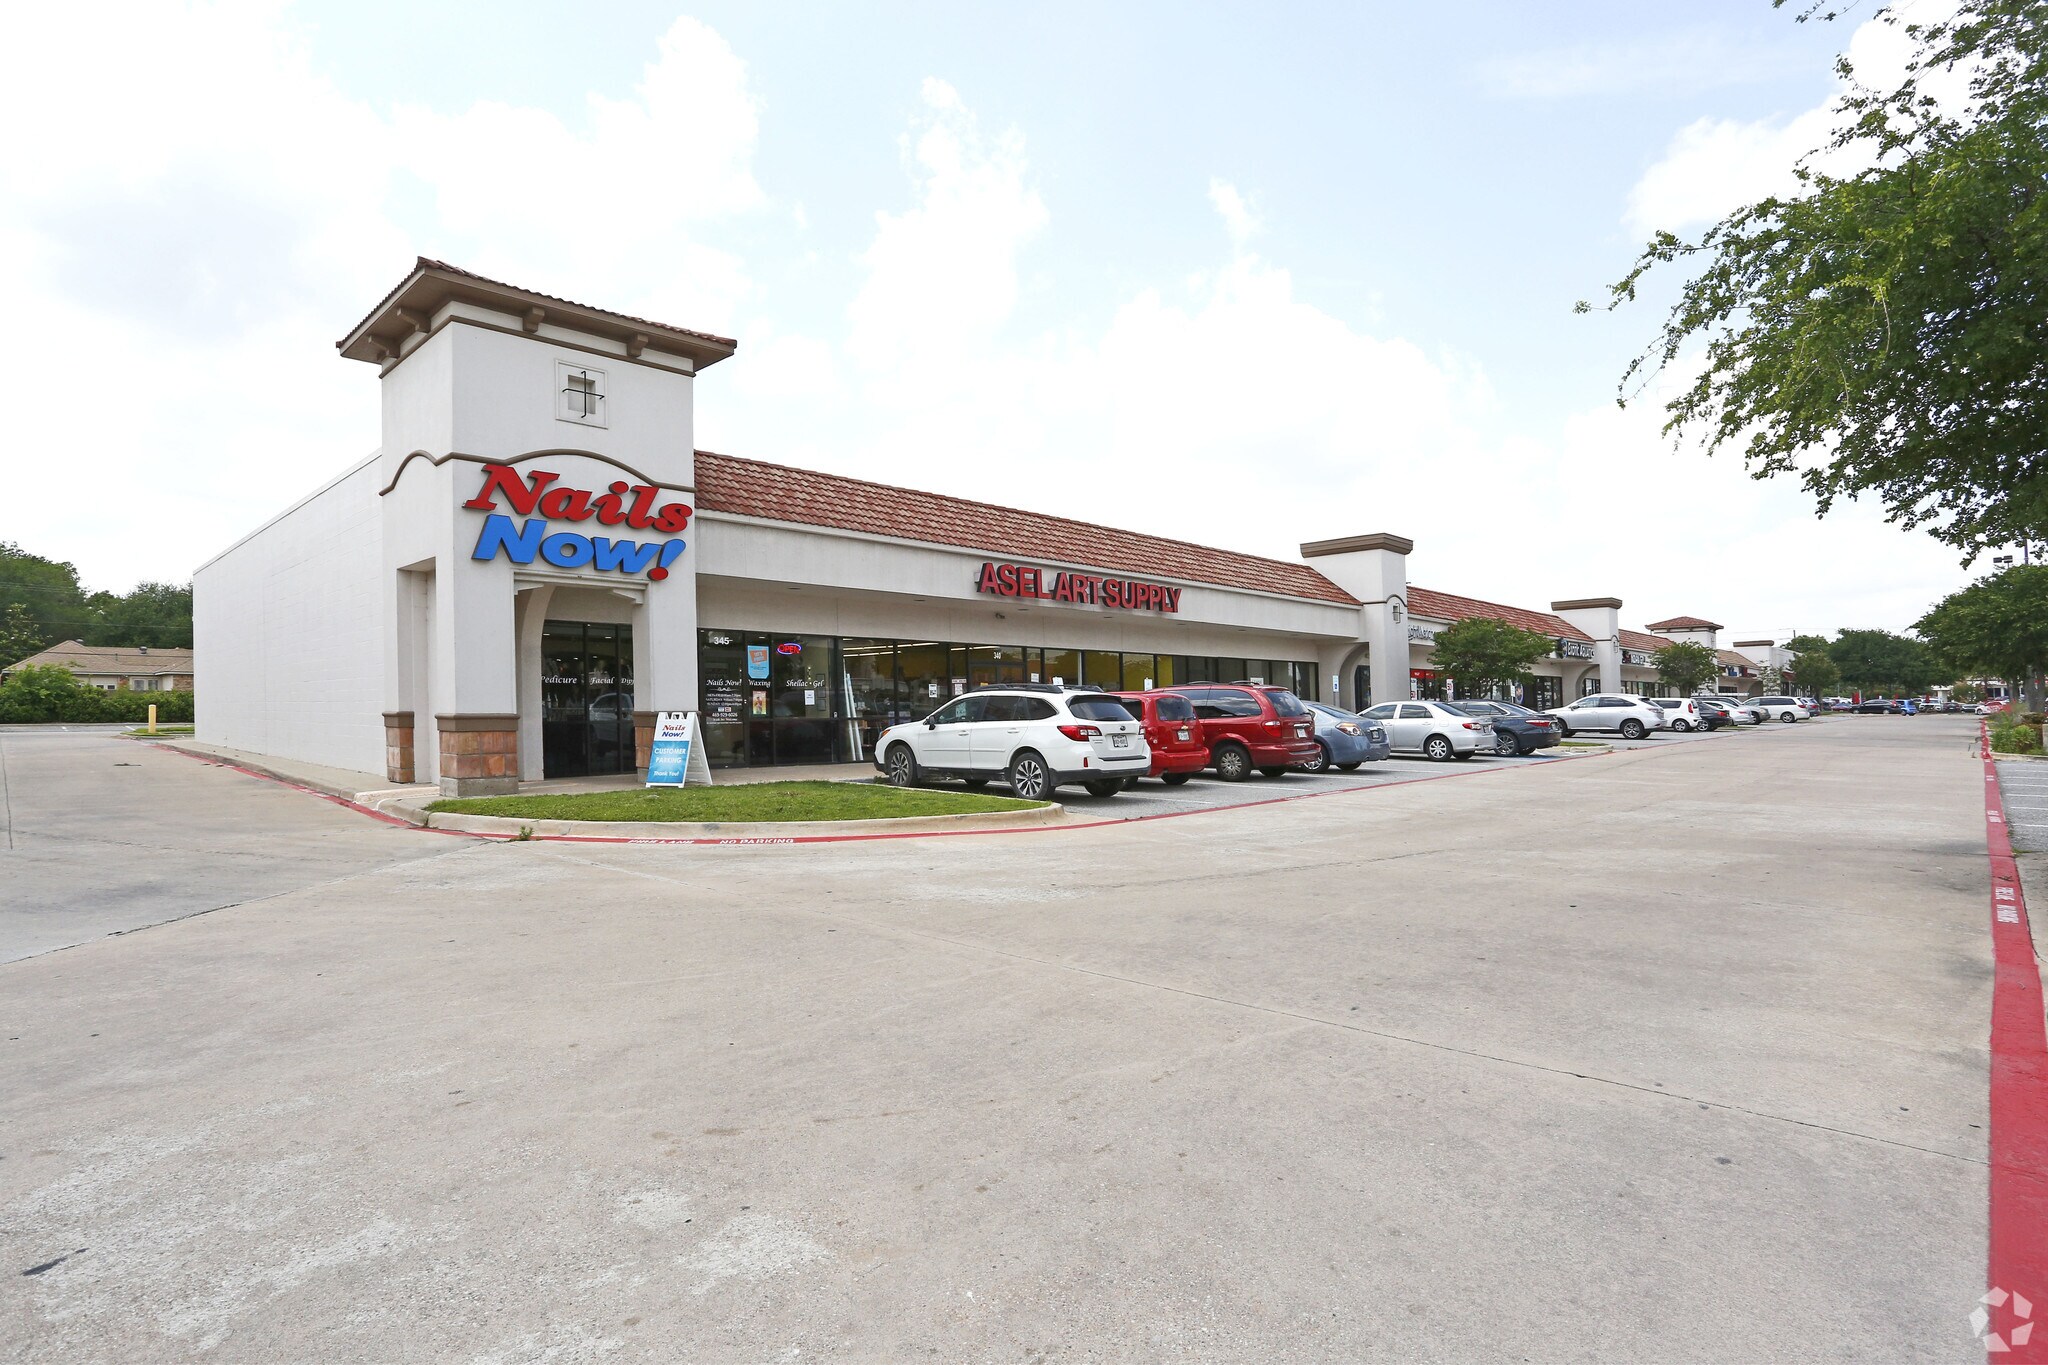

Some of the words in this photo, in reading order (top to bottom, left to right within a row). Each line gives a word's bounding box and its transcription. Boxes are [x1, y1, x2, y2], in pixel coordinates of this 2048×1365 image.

[462, 463, 693, 533] Nails
[471, 514, 686, 581] Now!
[976, 562, 1052, 599] ASEL
[1053, 571, 1103, 604] ART
[1102, 578, 1182, 613] SUPPLY
[713, 637, 730, 645] 345
[777, 643, 800, 654] OPEN
[590, 676, 615, 685] Facial
[724, 679, 742, 687] Now!
[748, 680, 771, 688] Waxing
[654, 747, 686, 755] CUSTOMER
